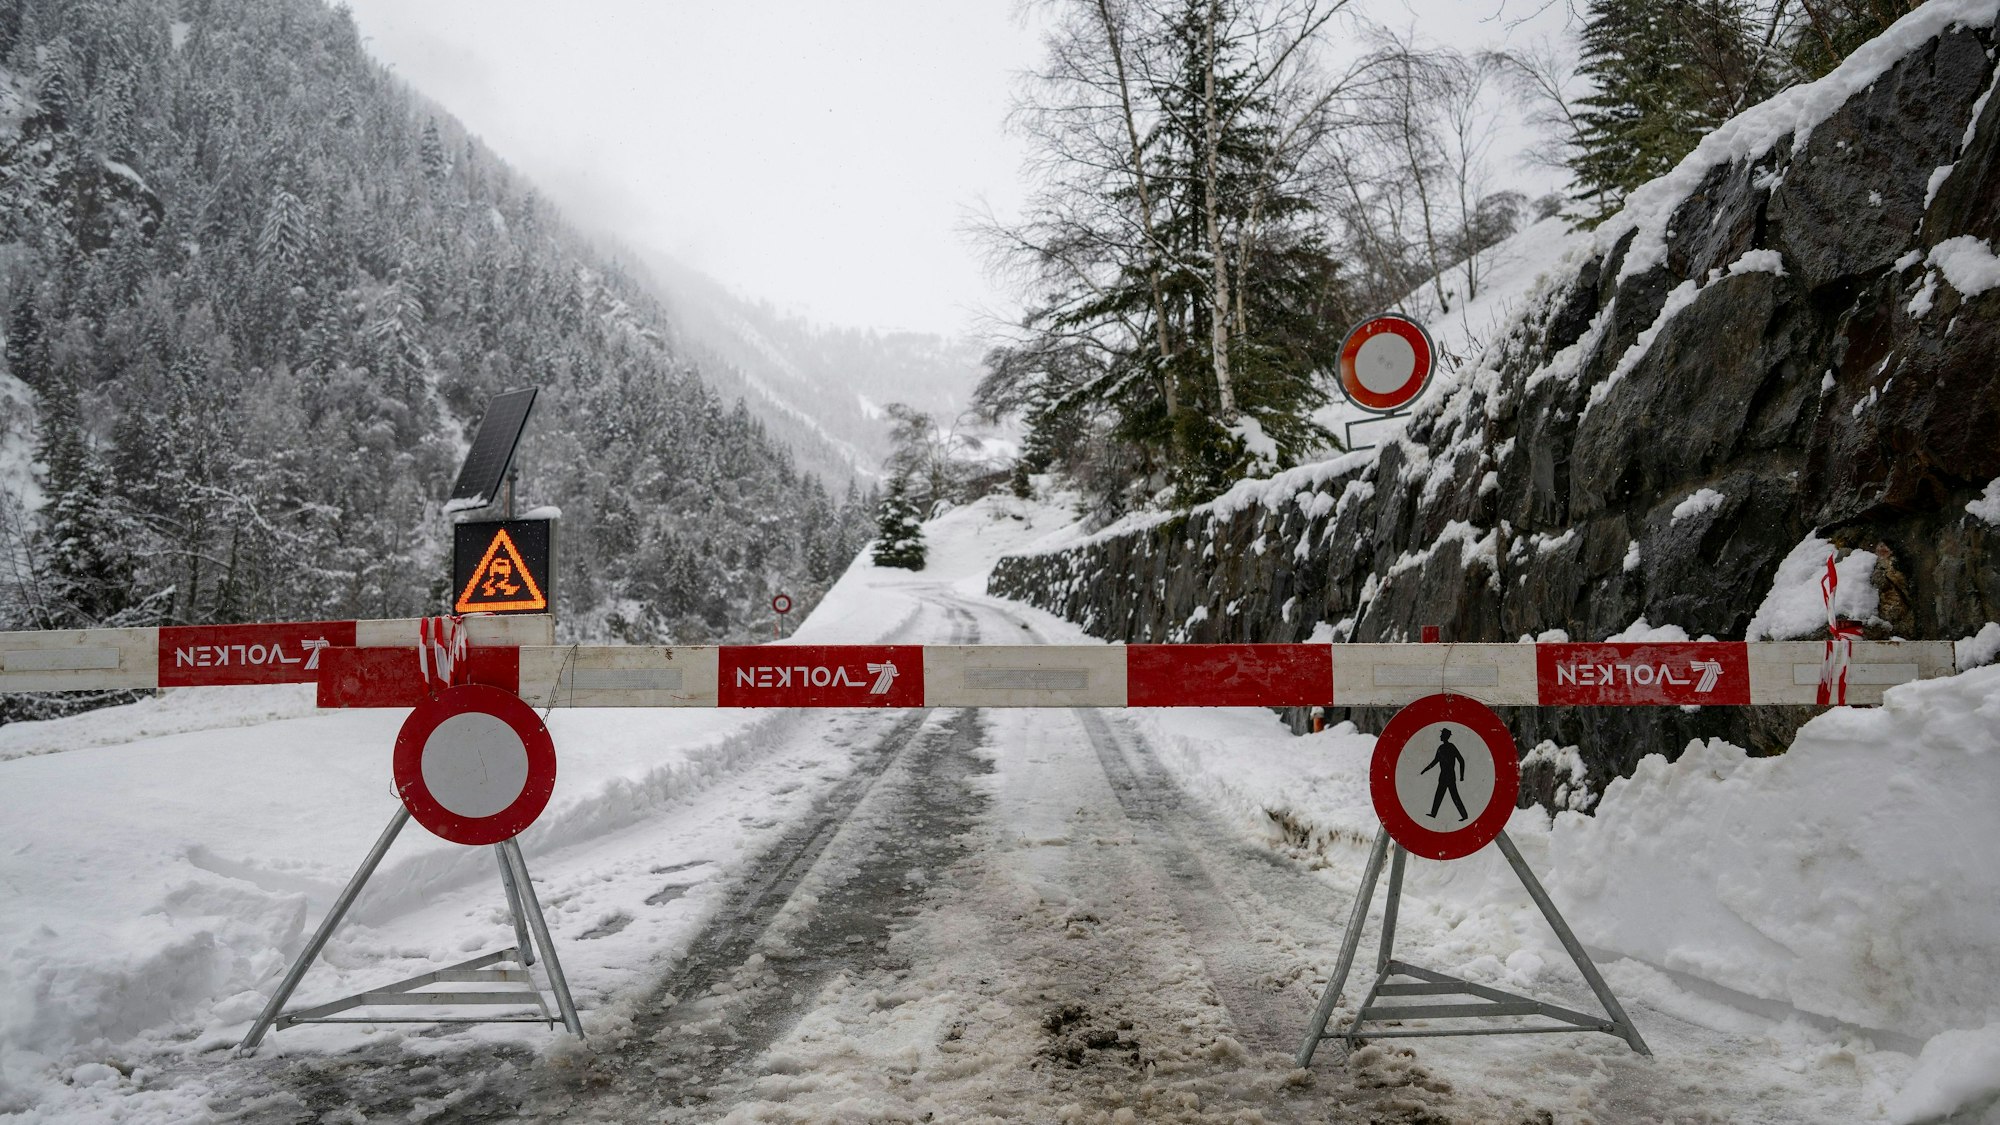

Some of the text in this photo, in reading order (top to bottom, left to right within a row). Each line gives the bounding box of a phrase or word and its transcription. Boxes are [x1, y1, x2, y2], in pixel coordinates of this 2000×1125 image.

[176, 643, 302, 667] VOLKEN
[736, 666, 867, 687] VOLKEN
[1557, 664, 1691, 685] VOLKEN
